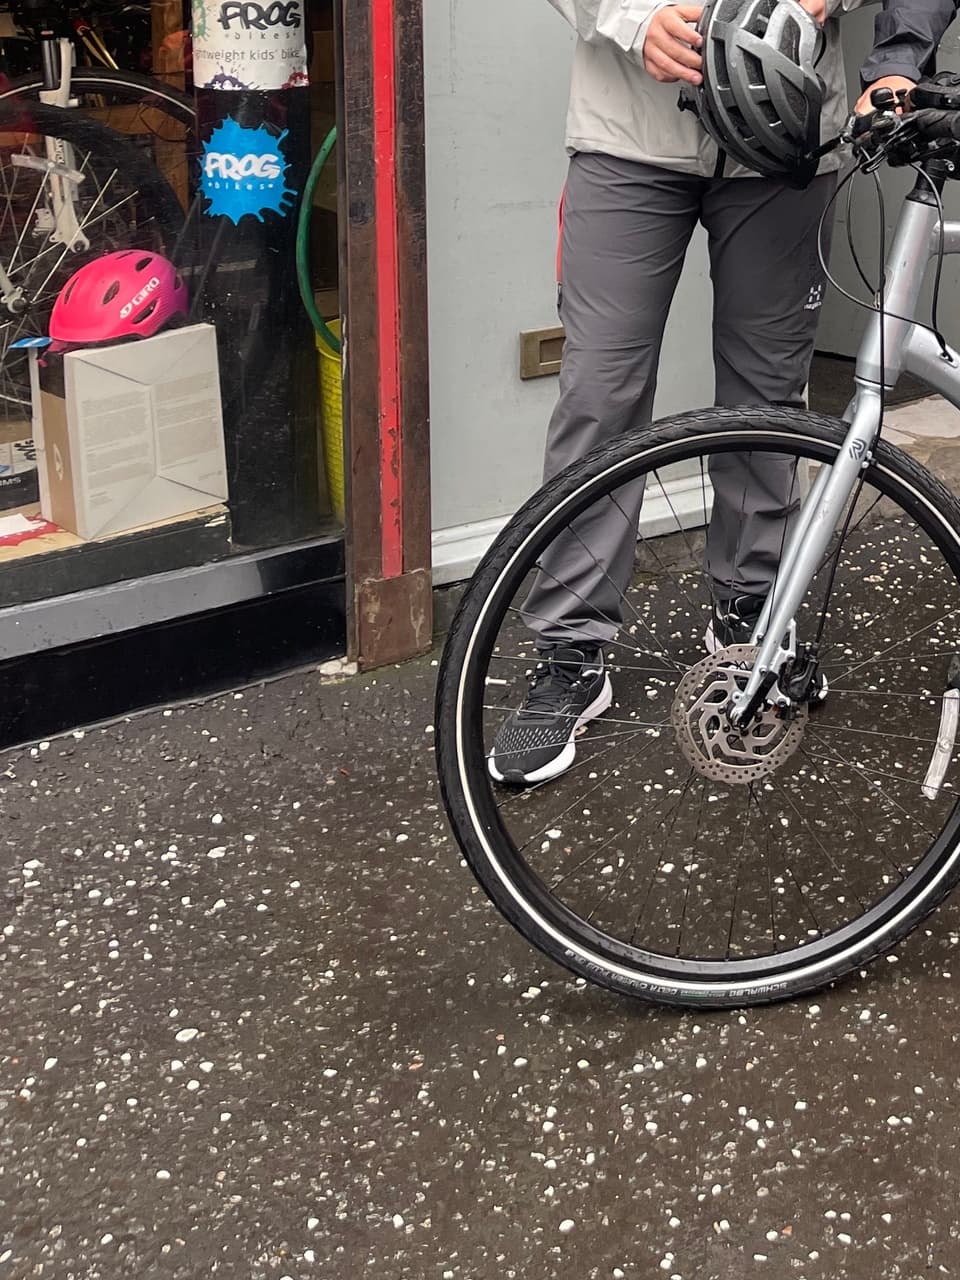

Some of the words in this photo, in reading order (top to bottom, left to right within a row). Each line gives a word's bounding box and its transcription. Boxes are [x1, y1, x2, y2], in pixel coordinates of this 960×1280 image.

[216, 0, 302, 31] FROG
[204, 151, 281, 180] FROG
[131, 276, 160, 307] GIRO
